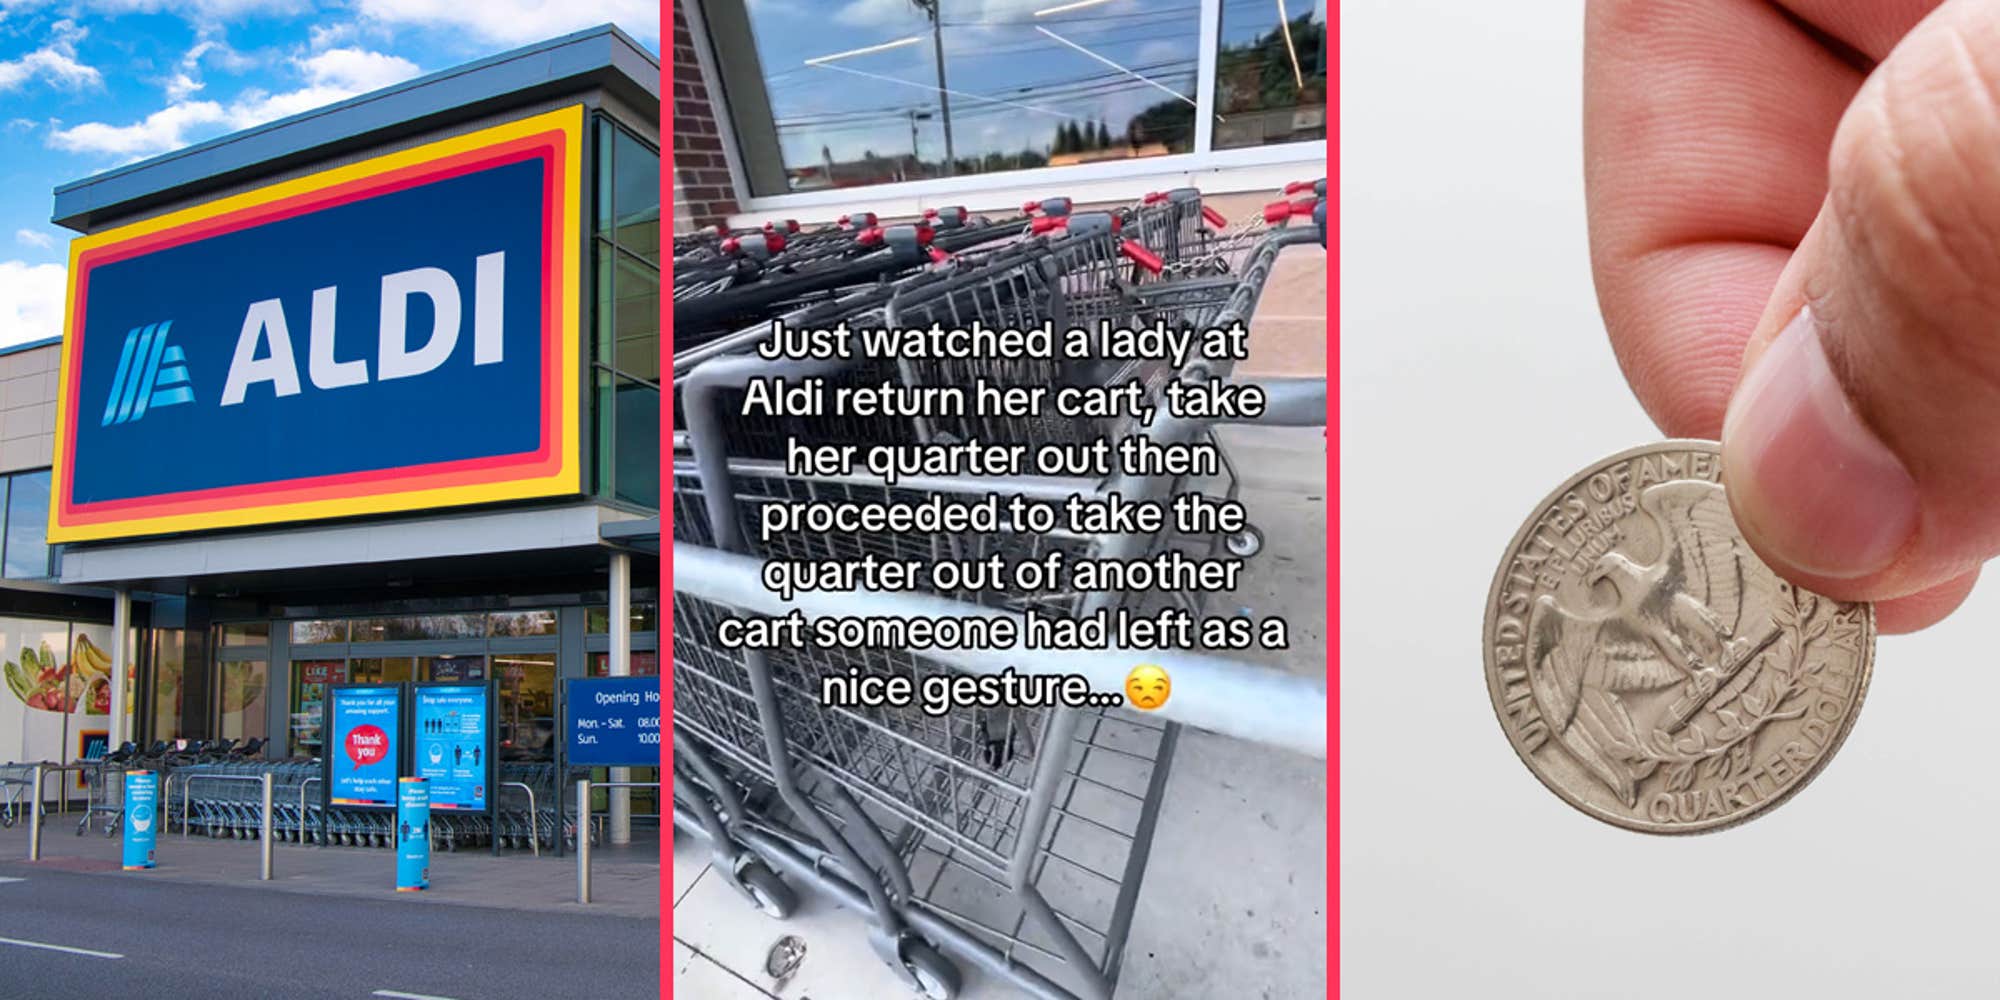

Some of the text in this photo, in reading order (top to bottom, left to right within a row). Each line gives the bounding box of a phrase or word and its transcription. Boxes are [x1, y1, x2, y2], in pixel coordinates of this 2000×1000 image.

[219, 251, 505, 406] ALDI
[1587, 461, 1631, 503] OF
[1503, 492, 1589, 613] STATES
[1550, 492, 1637, 576] PLURIBUS
[595, 690, 640, 706] Opening
[1497, 617, 1550, 755] UNITED
[577, 718, 599, 729] Mon.
[608, 718, 625, 729] Sat.
[1650, 607, 1864, 823] QUARTER DOLLAR
[352, 734, 381, 746] Thank
[357, 747, 376, 760] you
[577, 733, 598, 744] Sun.
